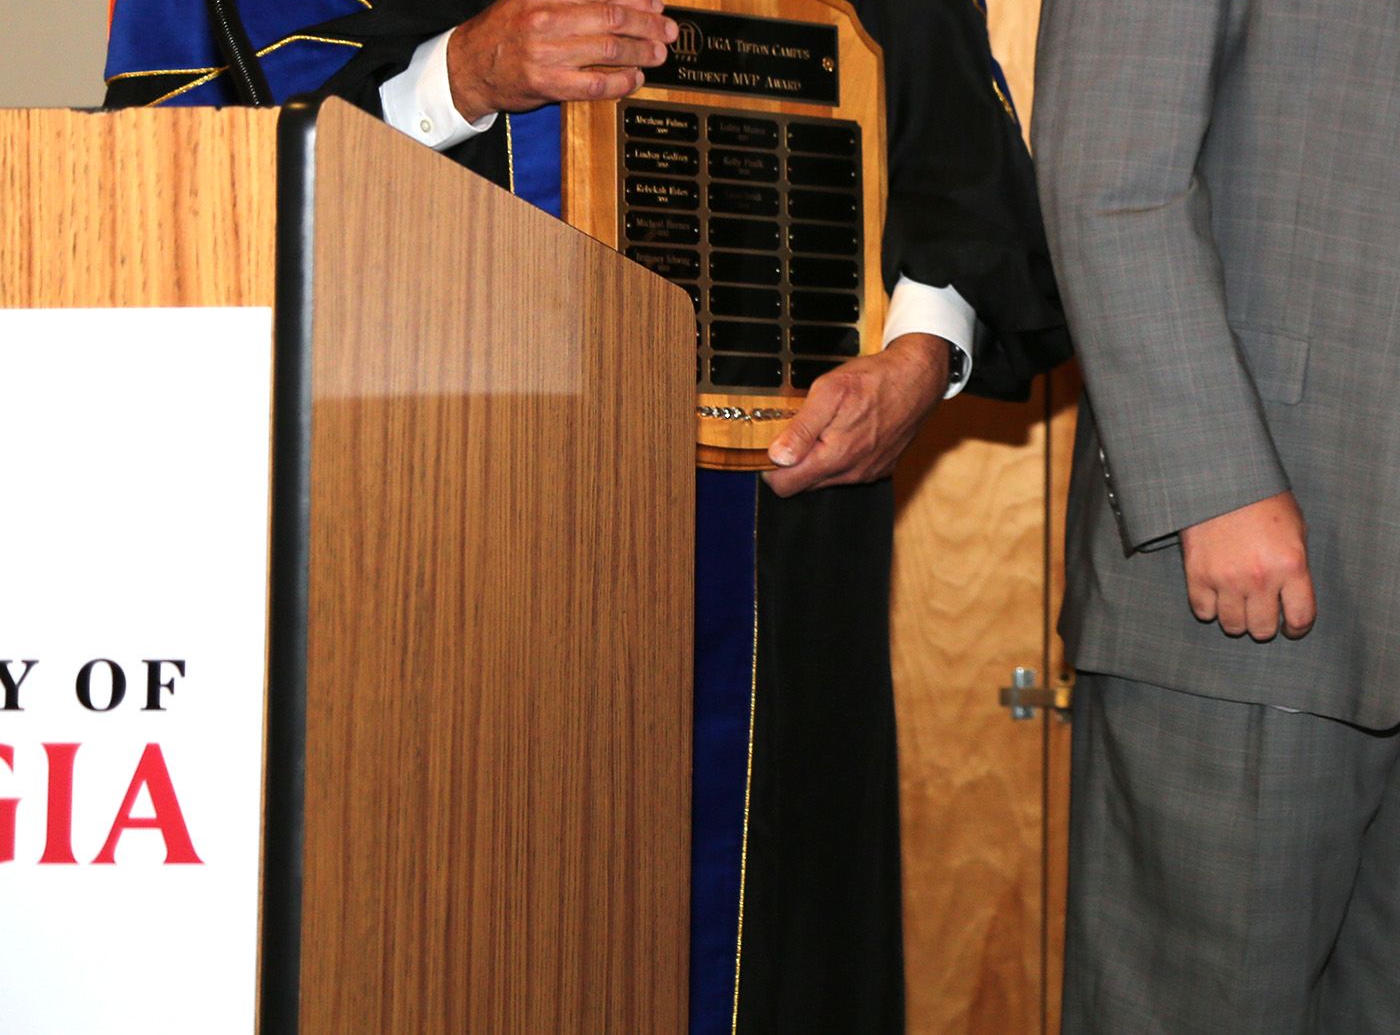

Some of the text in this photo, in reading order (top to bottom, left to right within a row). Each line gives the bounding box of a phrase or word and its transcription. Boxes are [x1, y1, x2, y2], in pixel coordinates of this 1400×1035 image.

[708, 36, 731, 51] UGA
[733, 72, 760, 87] MVP
[75, 658, 187, 712] OF
[0, 742, 206, 865] IA
